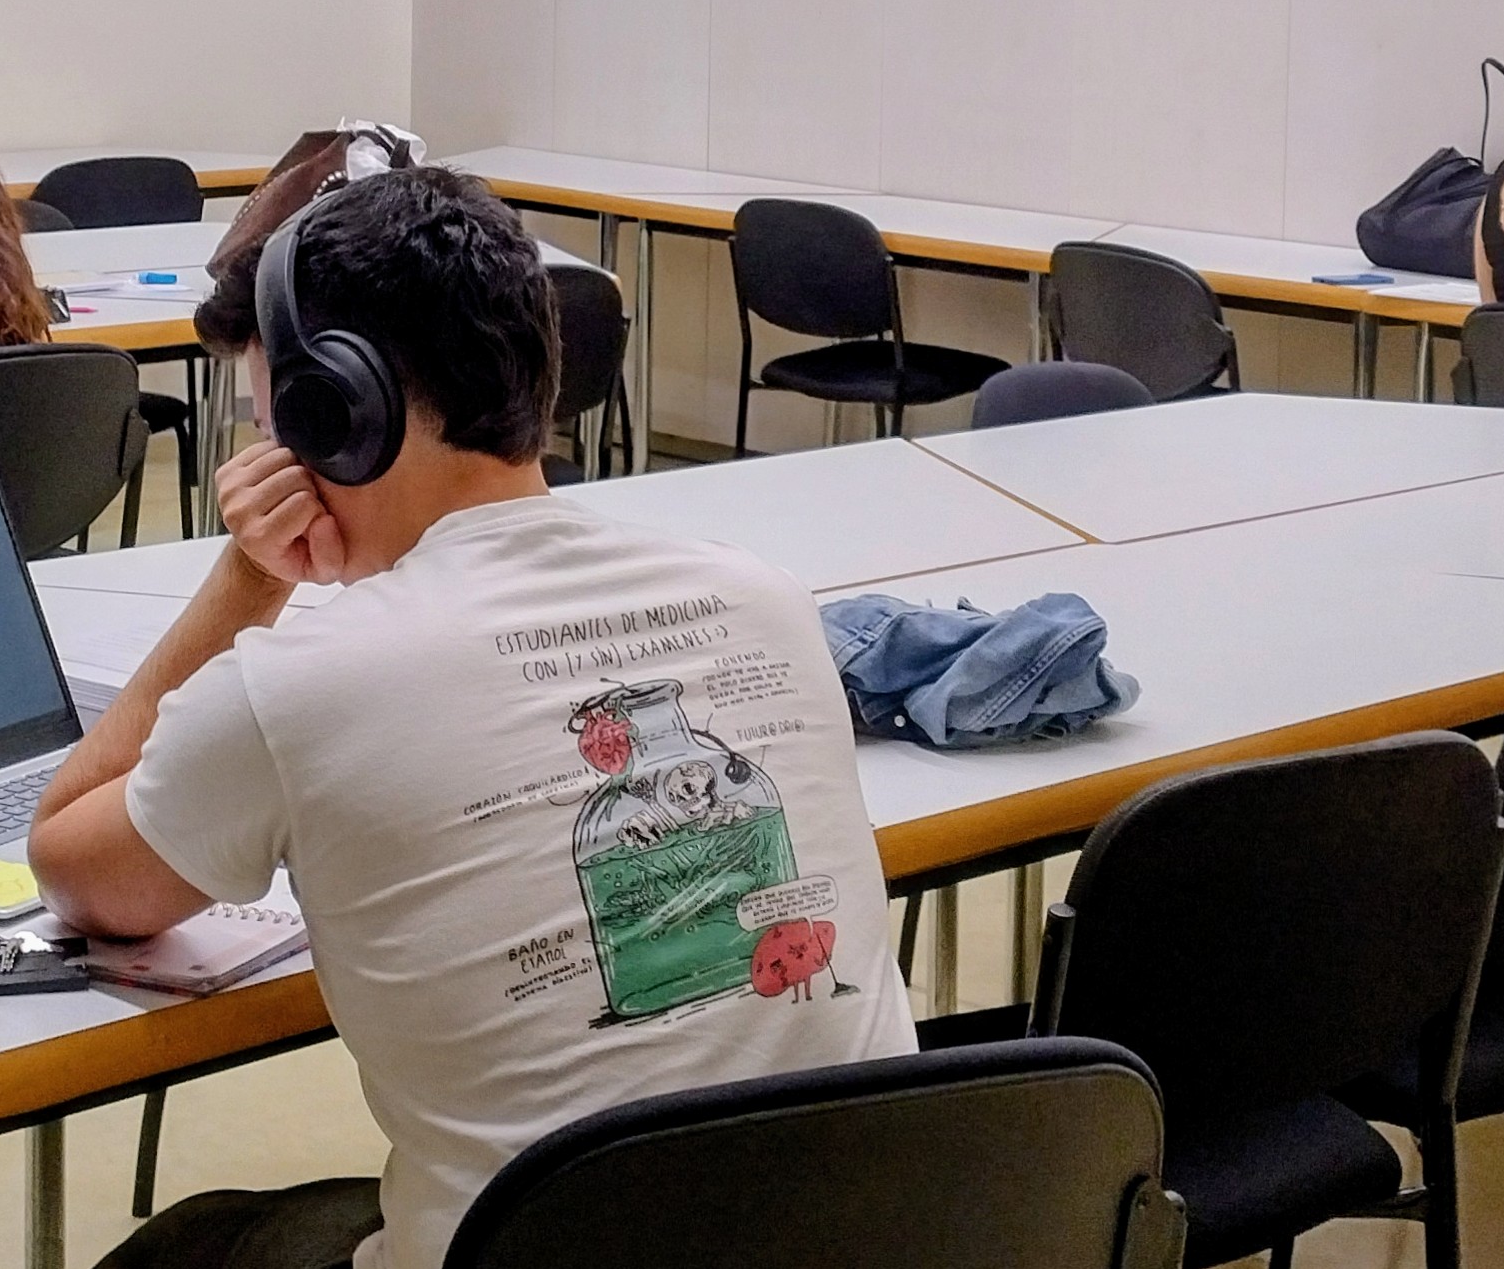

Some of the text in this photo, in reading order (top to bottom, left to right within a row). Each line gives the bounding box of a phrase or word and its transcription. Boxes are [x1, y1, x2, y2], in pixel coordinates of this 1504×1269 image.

[495, 594, 728, 656] ESTUDIANTES DE MEDICINA
[522, 659, 558, 683] CON
[714, 650, 766, 668] FONENDO
[508, 928, 574, 961] BAÑO EN
[520, 945, 567, 974] ETANOL
